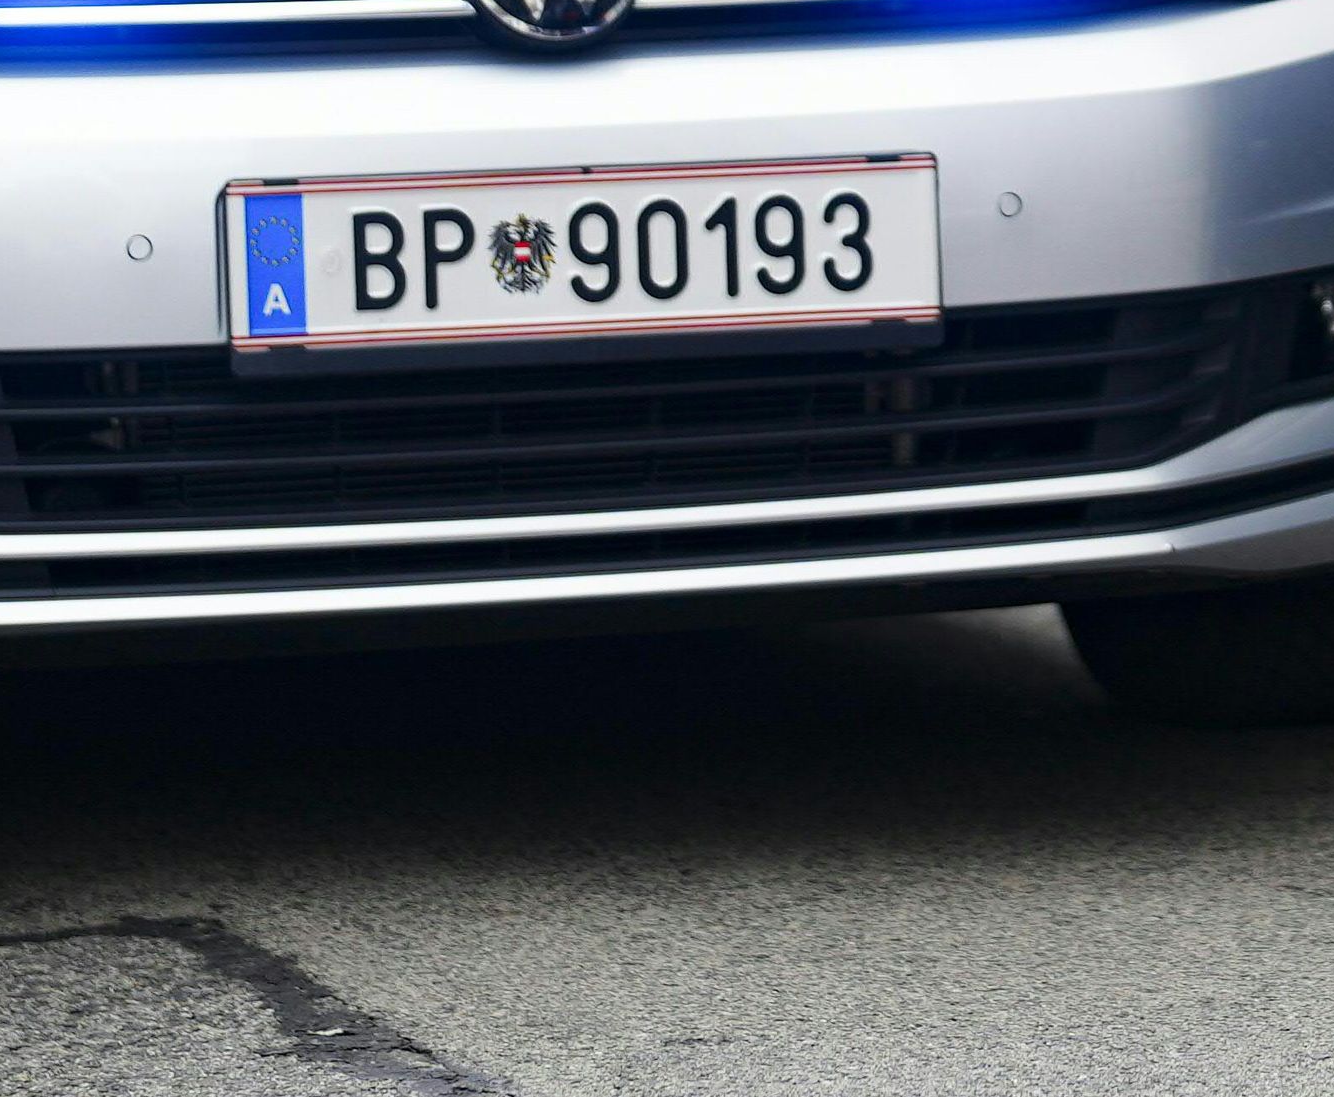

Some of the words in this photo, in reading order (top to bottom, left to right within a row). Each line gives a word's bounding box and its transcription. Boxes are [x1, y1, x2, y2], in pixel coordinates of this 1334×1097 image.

[352, 207, 475, 311] BP
[568, 191, 873, 303] 90193
[261, 282, 293, 317] A
